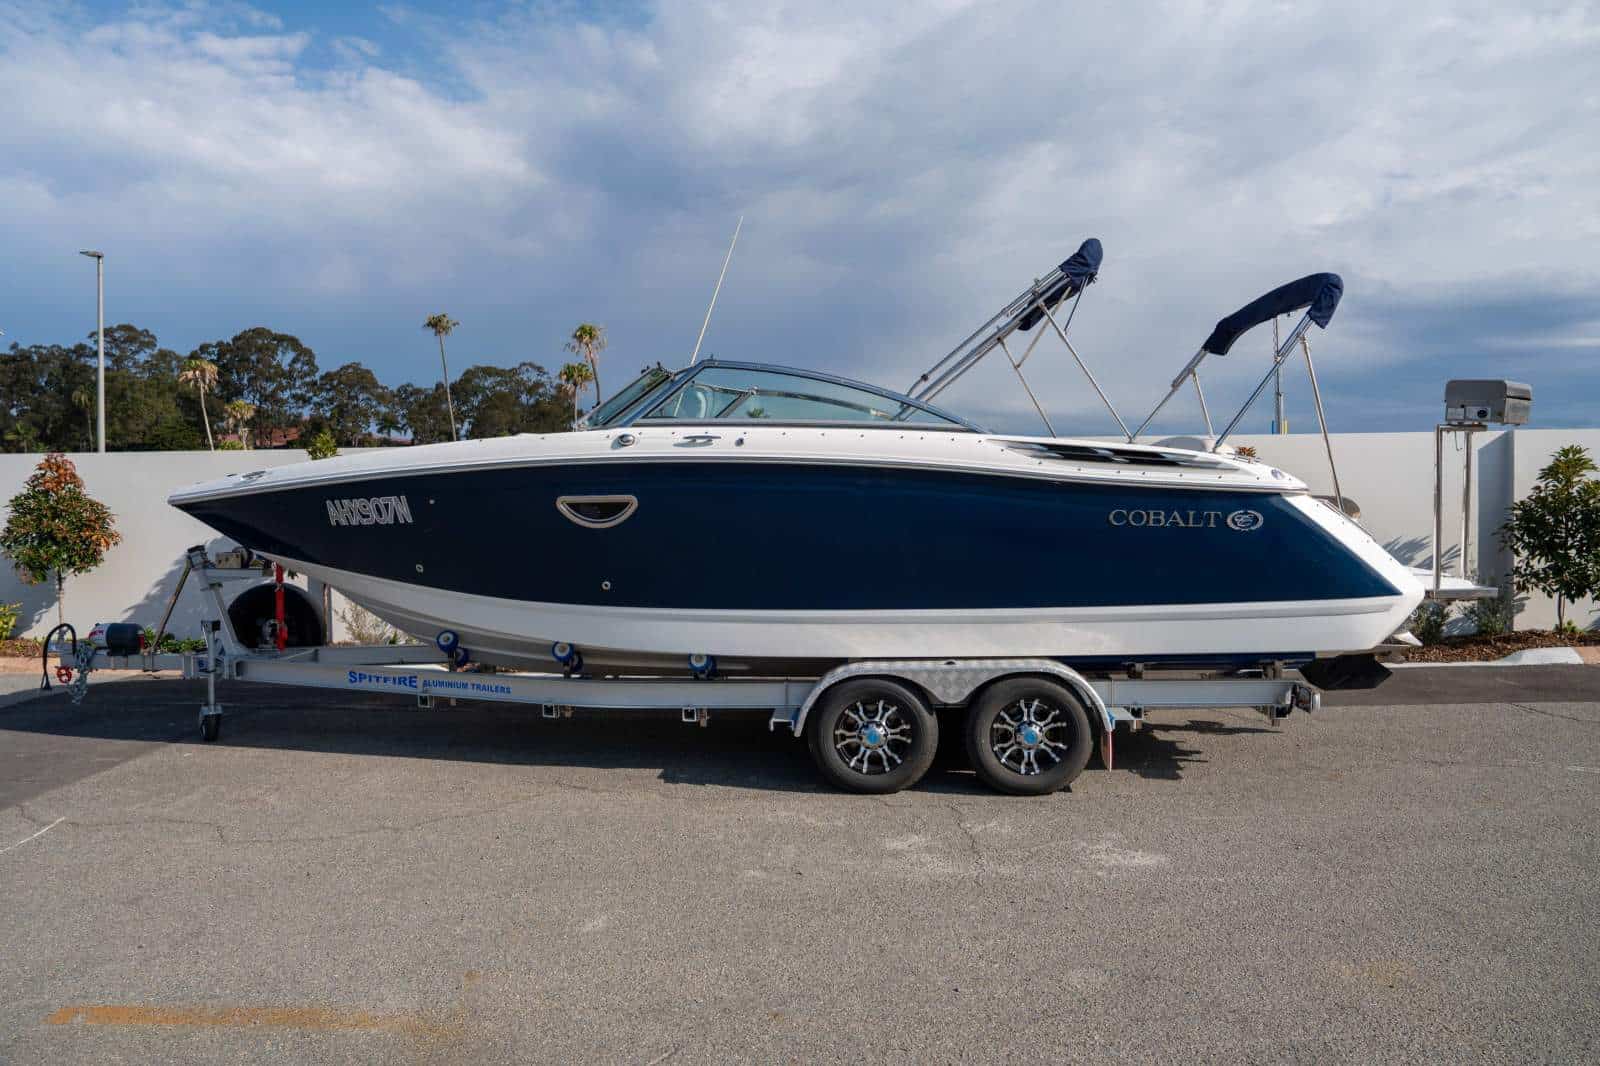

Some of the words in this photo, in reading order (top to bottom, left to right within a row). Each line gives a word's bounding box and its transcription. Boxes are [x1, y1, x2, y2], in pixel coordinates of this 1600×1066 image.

[1108, 509, 1222, 528] COBALT
[348, 670, 418, 689] SPITFIRE
[423, 679, 469, 690] ALUMINIUM
[471, 683, 512, 695] TRAILERS
